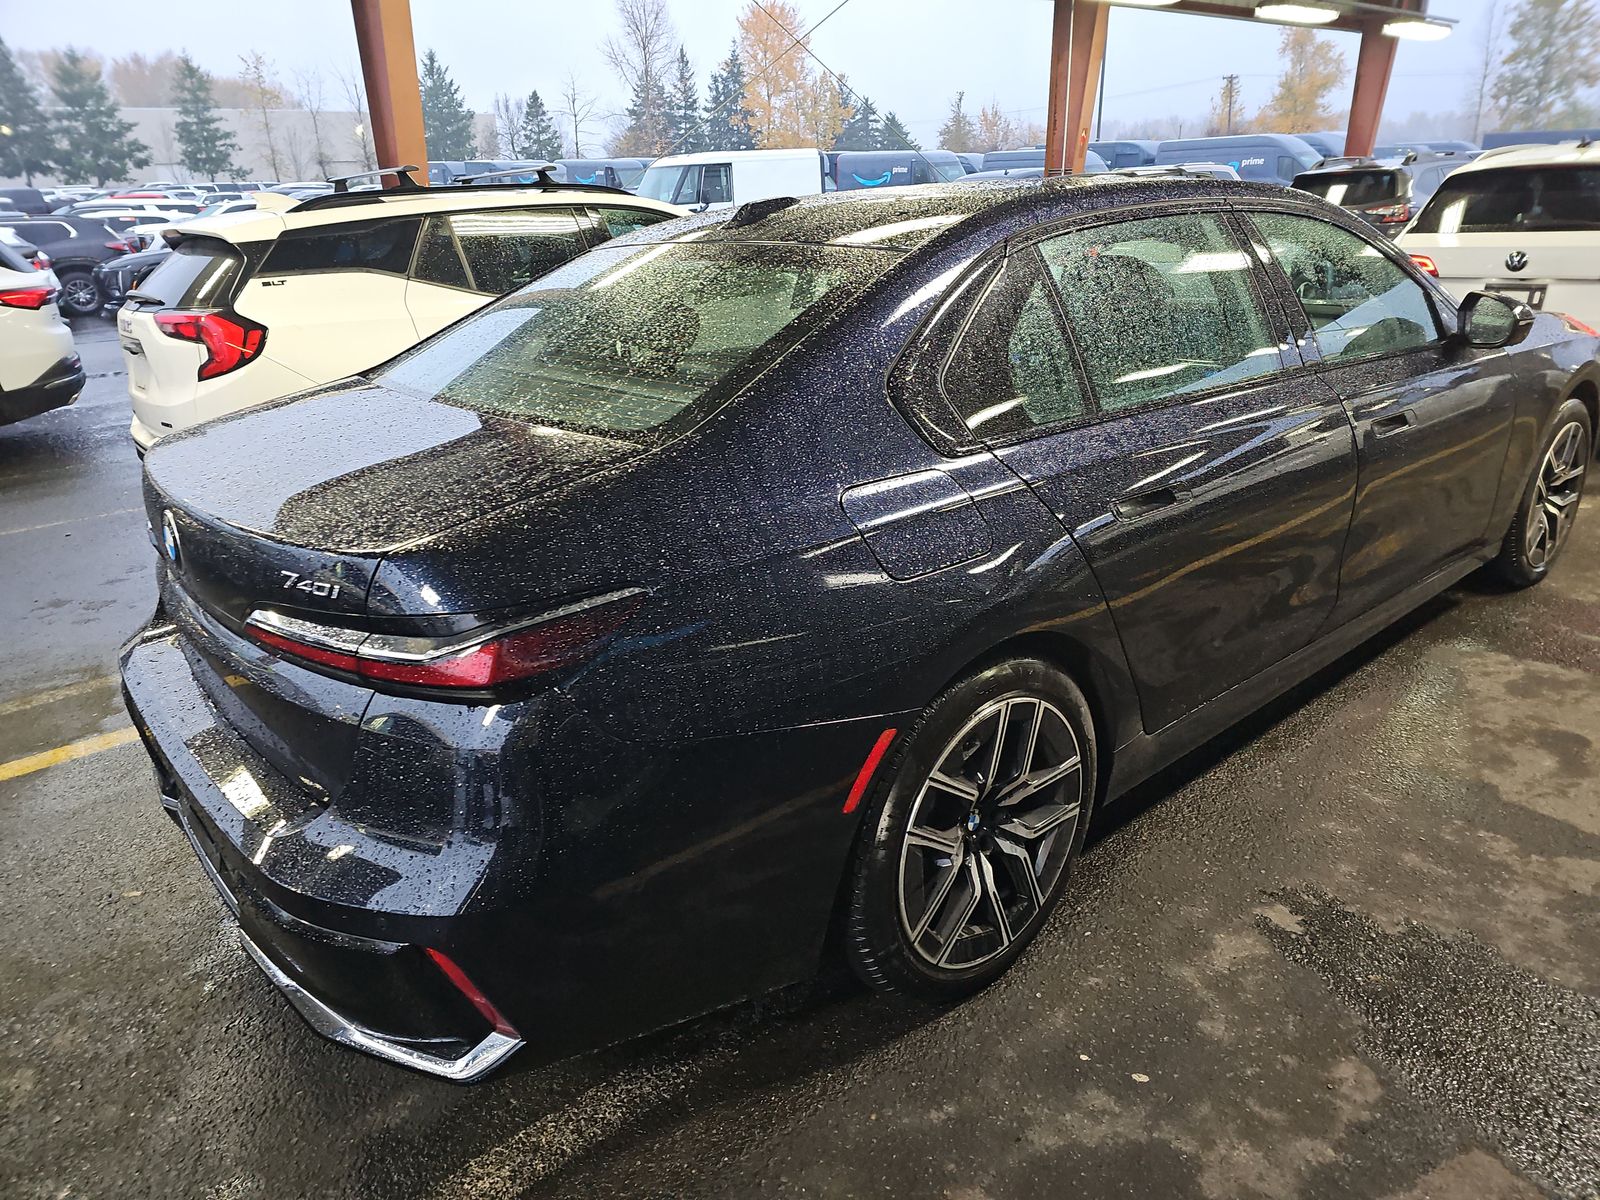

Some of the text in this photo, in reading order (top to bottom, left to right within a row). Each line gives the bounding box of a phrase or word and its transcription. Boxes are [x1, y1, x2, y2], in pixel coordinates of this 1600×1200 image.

[1242, 157, 1265, 167] prime
[892, 166, 908, 174] prime
[281, 570, 340, 599] 740i
